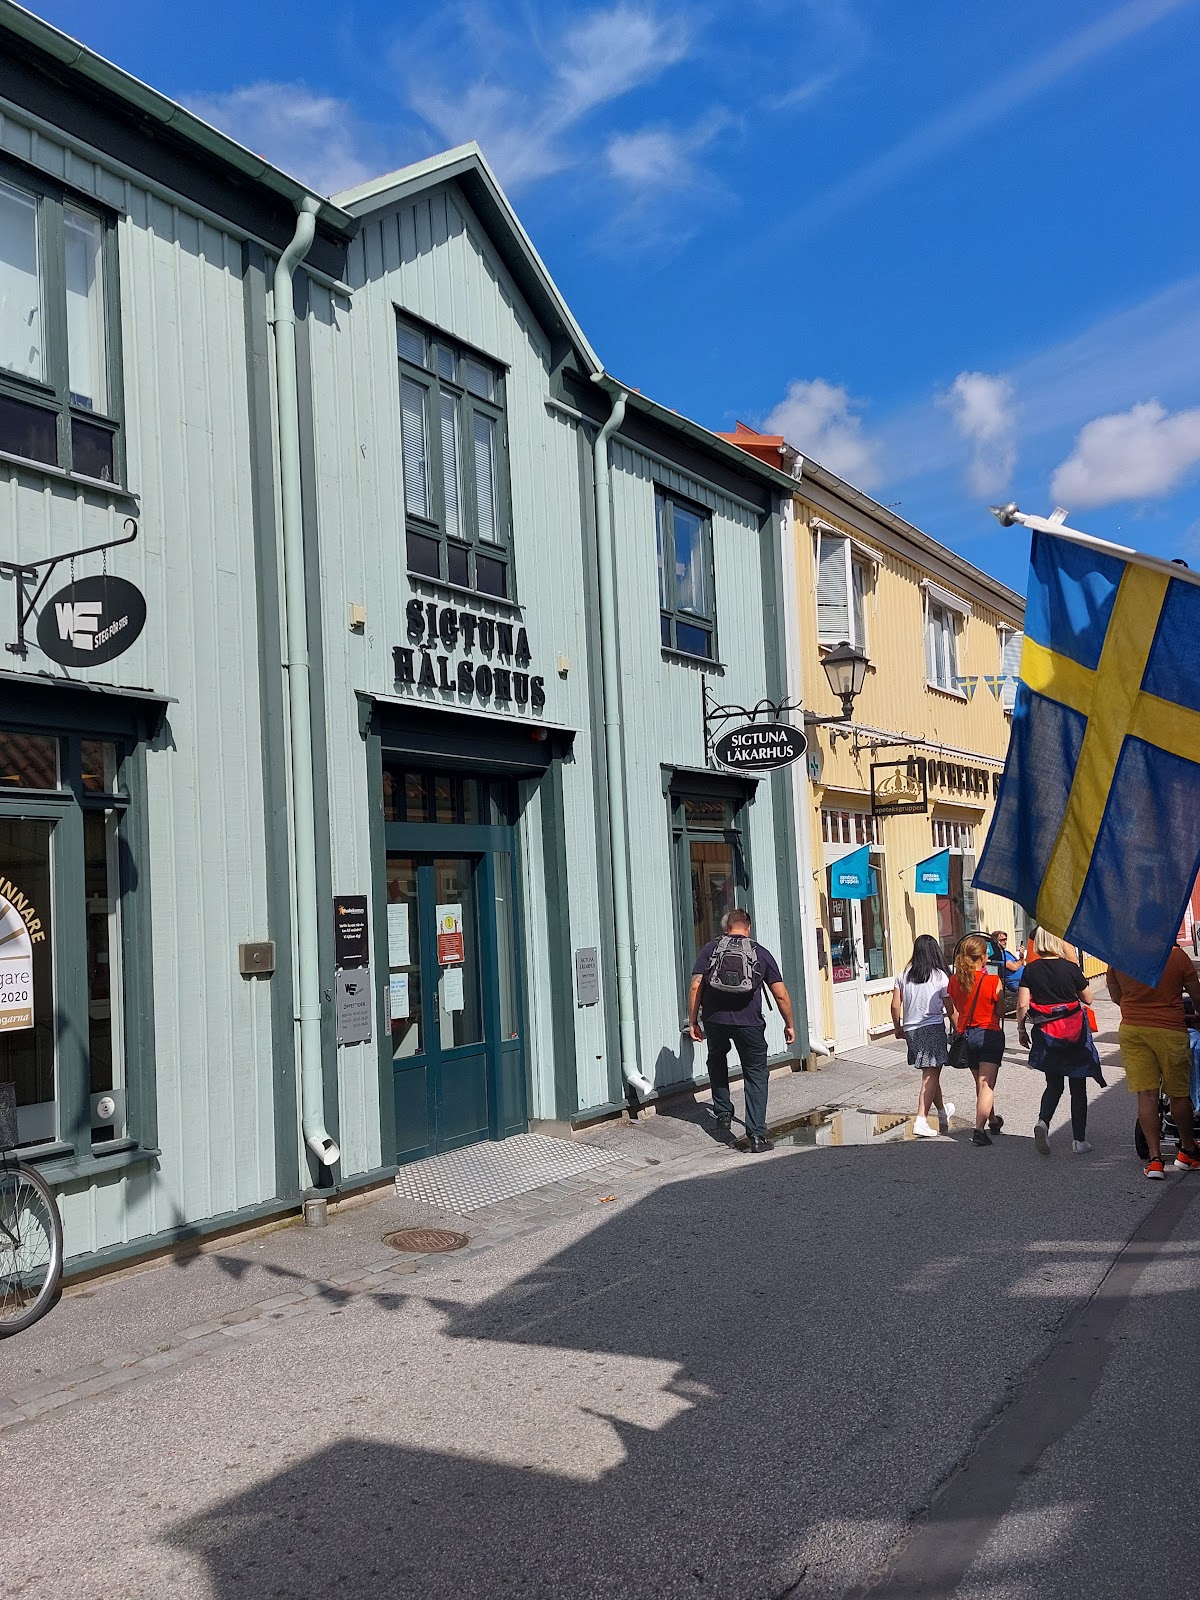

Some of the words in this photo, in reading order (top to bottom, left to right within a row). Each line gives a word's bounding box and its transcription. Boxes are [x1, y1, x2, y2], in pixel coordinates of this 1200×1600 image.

[94, 629, 109, 648] STEG
[109, 621, 119, 638] FÖR
[118, 615, 129, 631] STEG
[405, 598, 532, 660] SIGTUNA
[392, 644, 546, 708] HÄLSOHUS
[731, 730, 788, 747] SIGTUNA
[727, 745, 794, 763] LÄKARHUS
[875, 804, 925, 815] apoteksgruppen
[1, 990, 28, 1003] 2020
